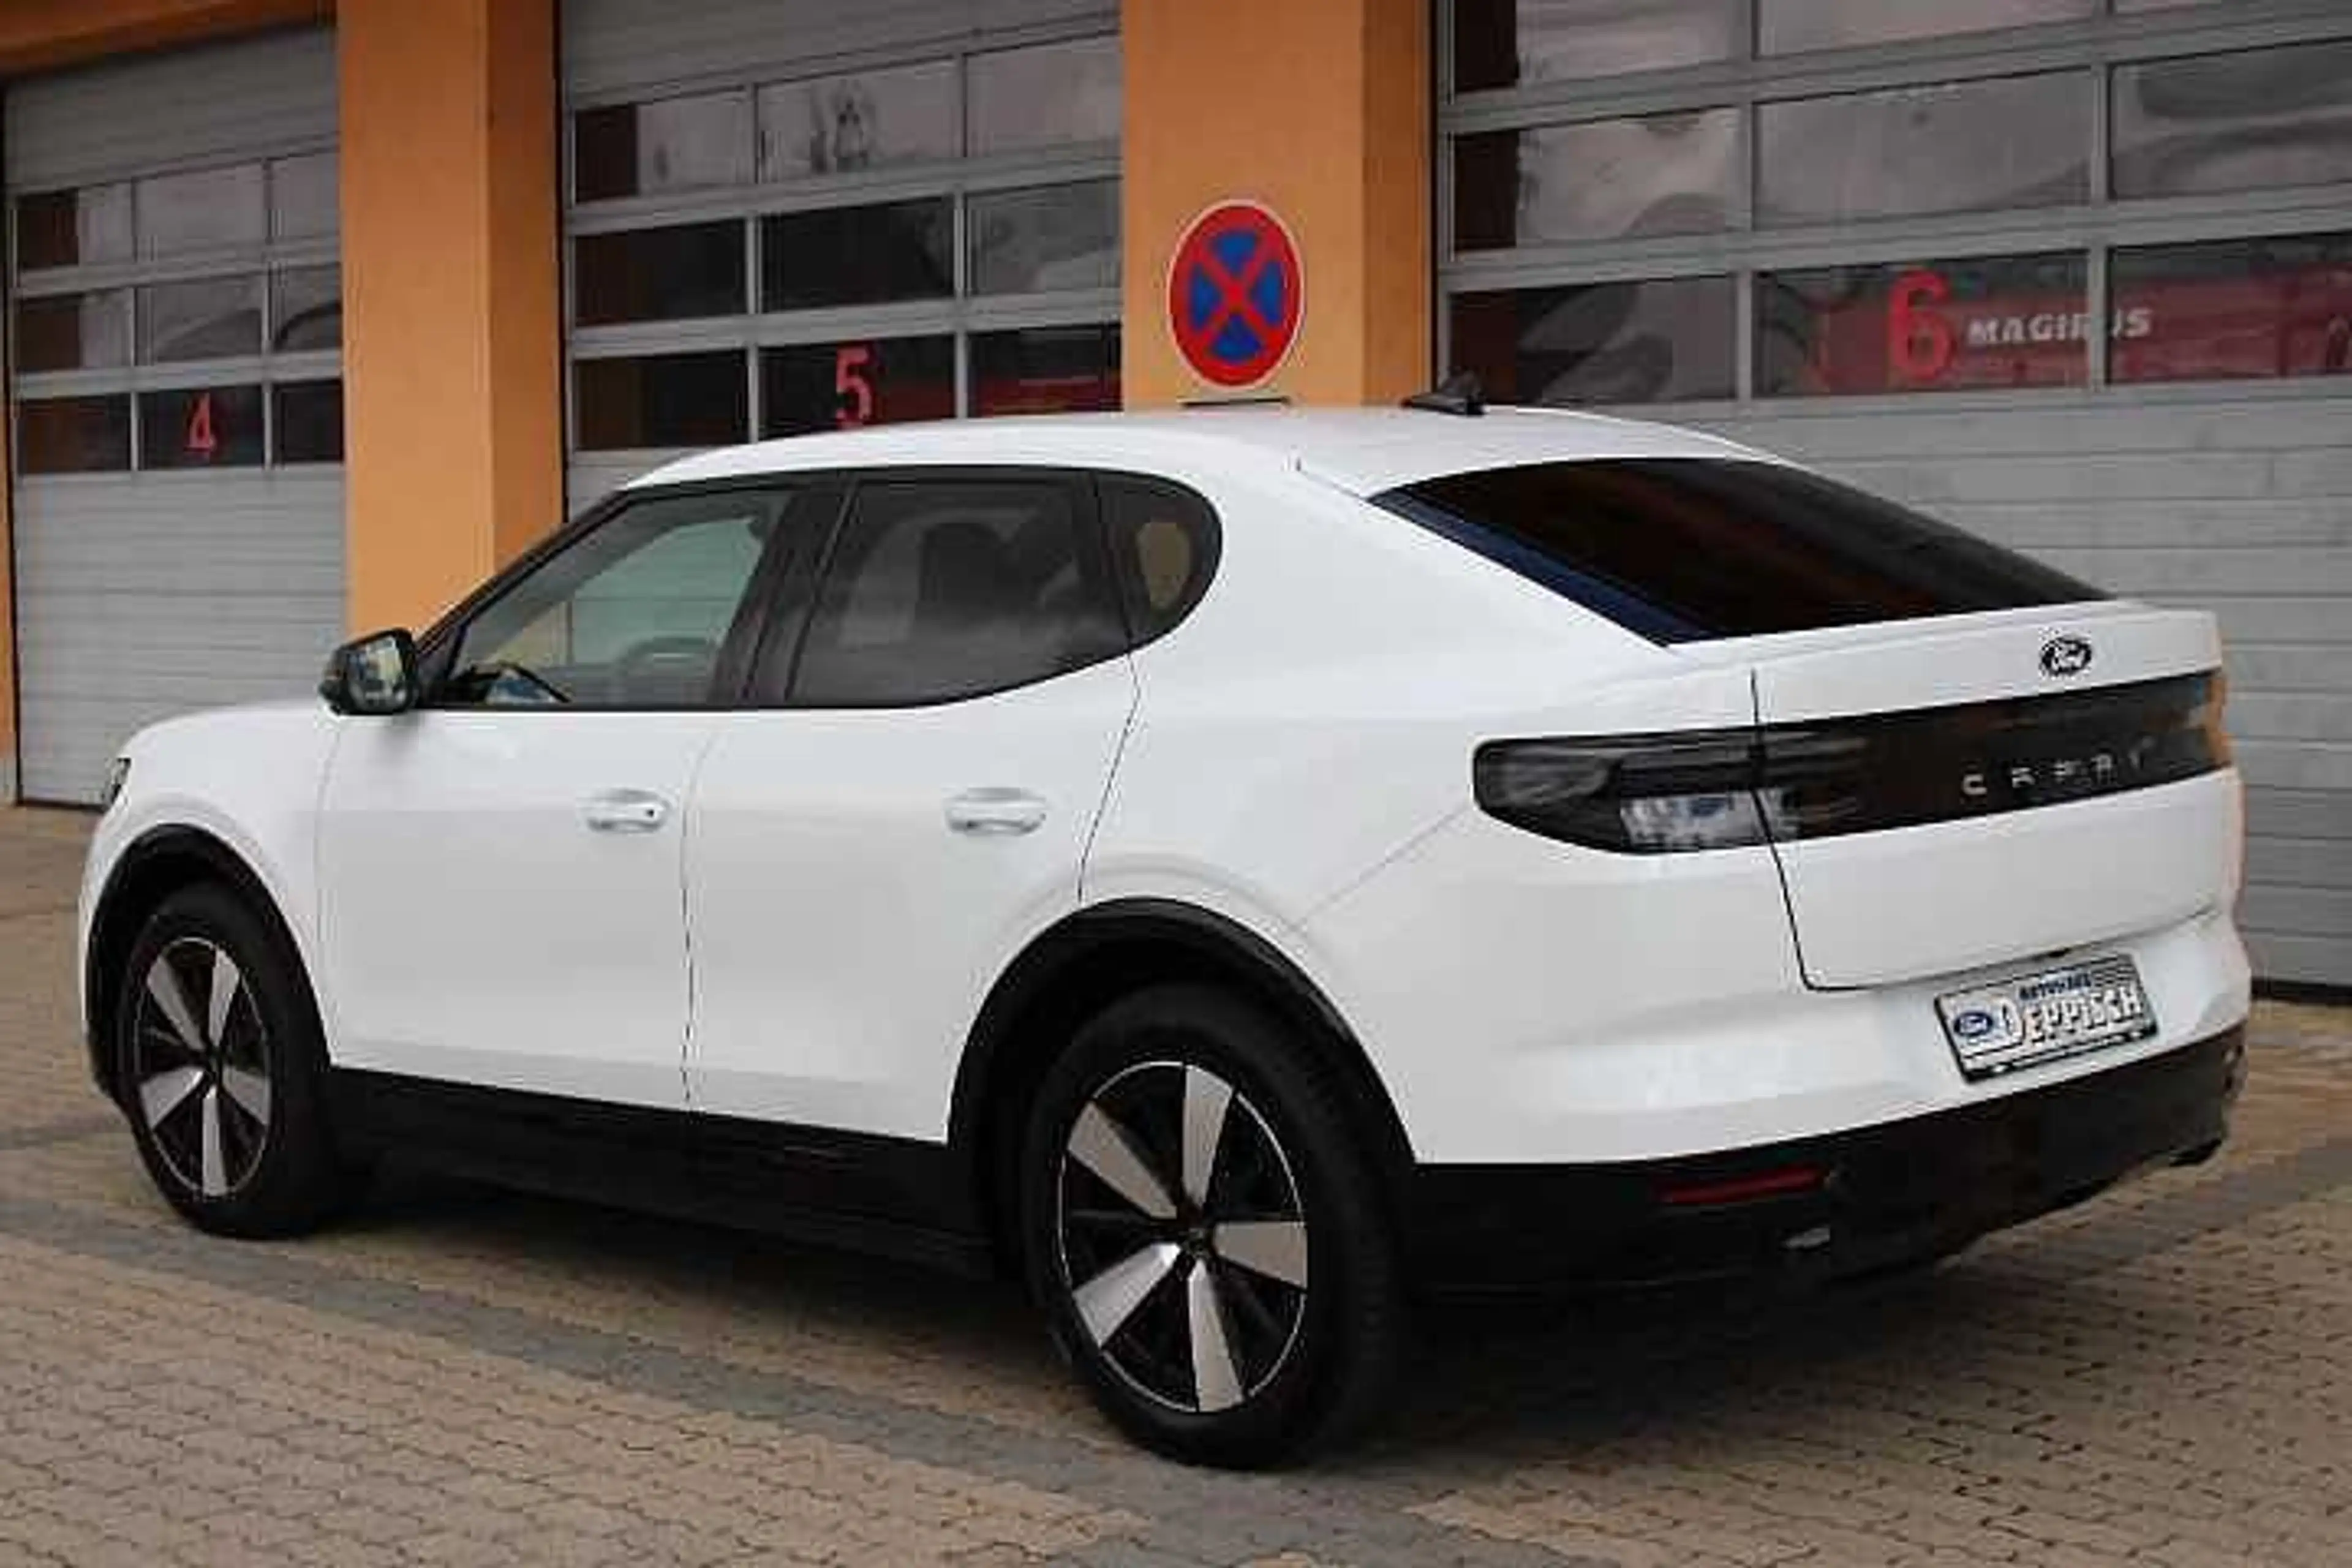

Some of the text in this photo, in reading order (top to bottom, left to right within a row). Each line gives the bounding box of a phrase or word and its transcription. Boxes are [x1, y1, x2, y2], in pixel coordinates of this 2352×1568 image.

[1890, 268, 1954, 380] 6
[186, 391, 216, 463] 4
[835, 343, 873, 429] 5
